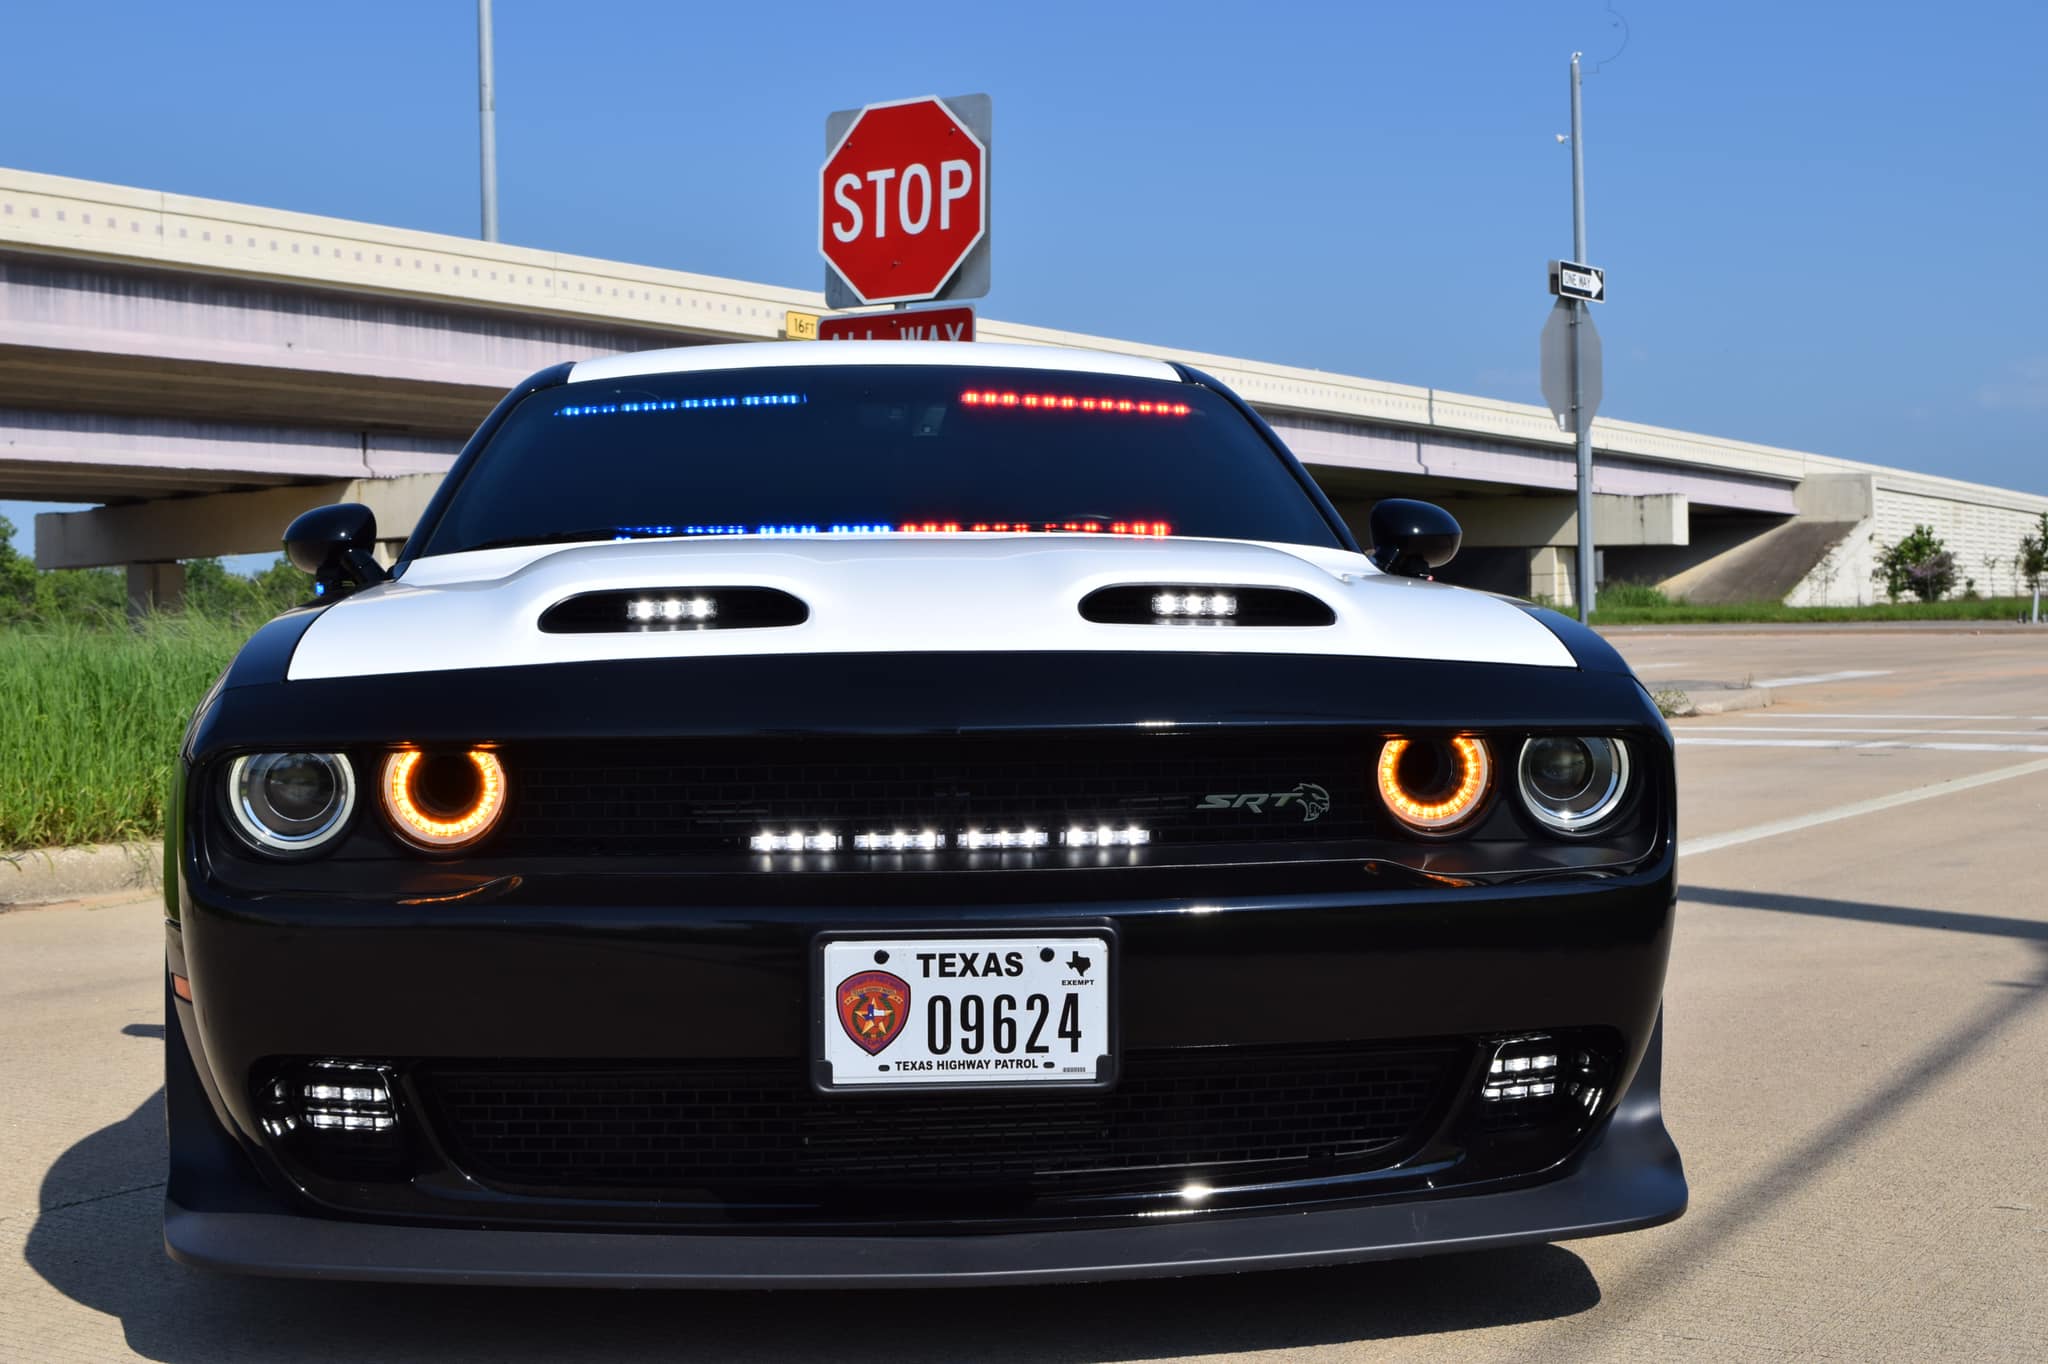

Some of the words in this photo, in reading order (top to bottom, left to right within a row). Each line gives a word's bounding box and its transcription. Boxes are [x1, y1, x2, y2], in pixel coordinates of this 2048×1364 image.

[832, 158, 973, 243] STOP
[1196, 792, 1304, 814] SRT
[916, 951, 1024, 978] TEXAS
[927, 992, 1083, 1055] 09624
[895, 1060, 933, 1072] TEXAS
[936, 1059, 991, 1071] HIGHWAY
[994, 1058, 1039, 1070] PATROL
